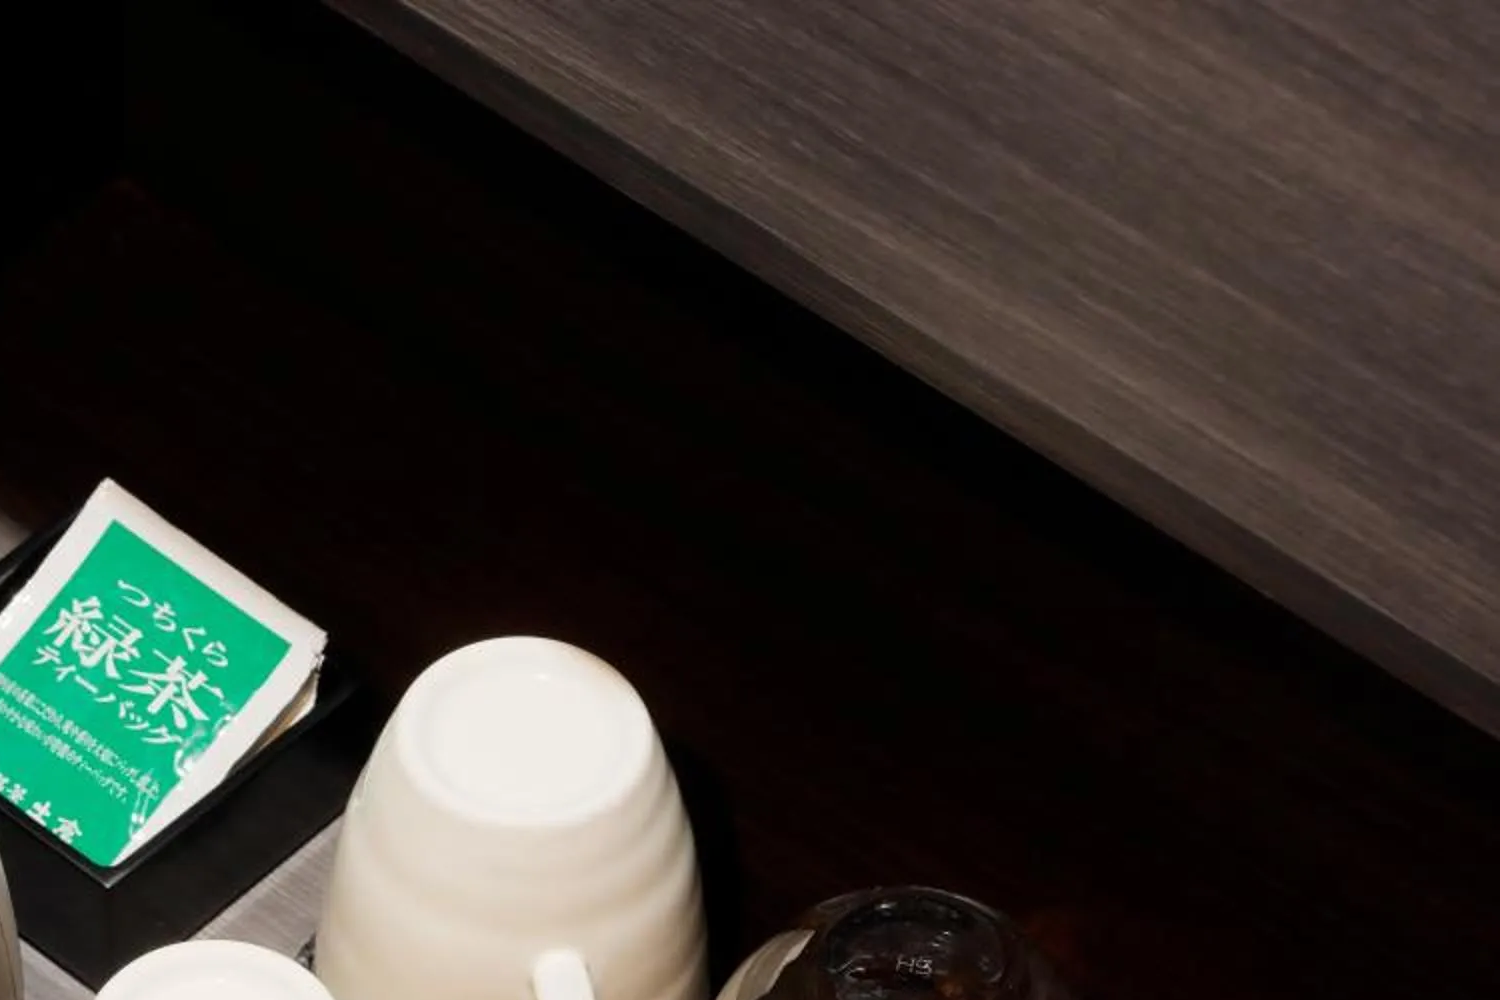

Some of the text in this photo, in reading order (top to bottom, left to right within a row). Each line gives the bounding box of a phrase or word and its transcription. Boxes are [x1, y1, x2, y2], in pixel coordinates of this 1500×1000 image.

[43, 596, 225, 728] 緑茶
[117, 579, 228, 667] つちくら
[32, 645, 182, 744] ティーバッグ
